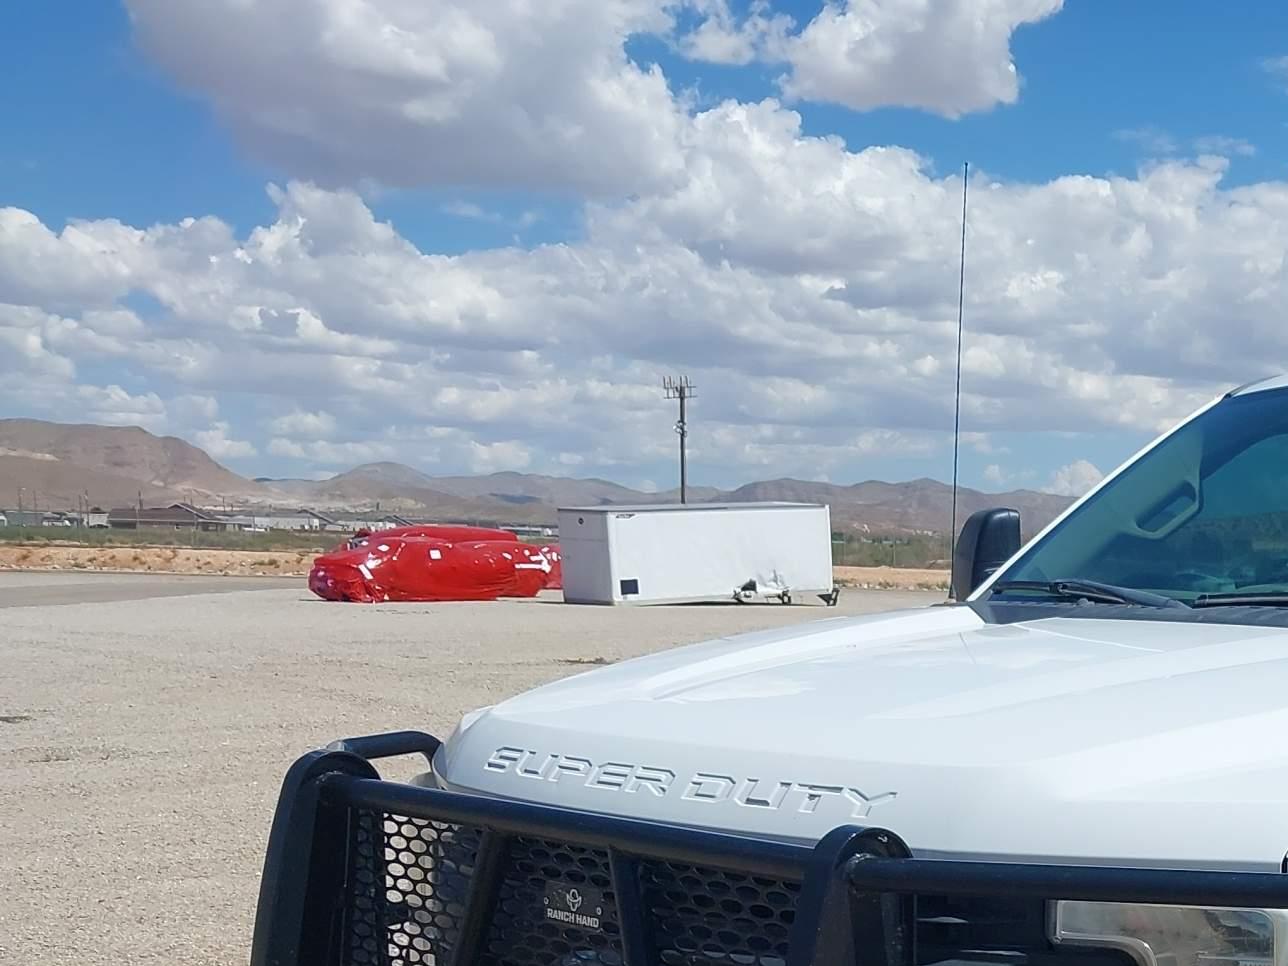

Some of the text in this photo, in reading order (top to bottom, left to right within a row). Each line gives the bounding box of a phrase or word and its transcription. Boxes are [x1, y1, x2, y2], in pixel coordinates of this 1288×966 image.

[484, 746, 898, 818] SUPER DUTY
[547, 908, 599, 928] RANCH HAND
